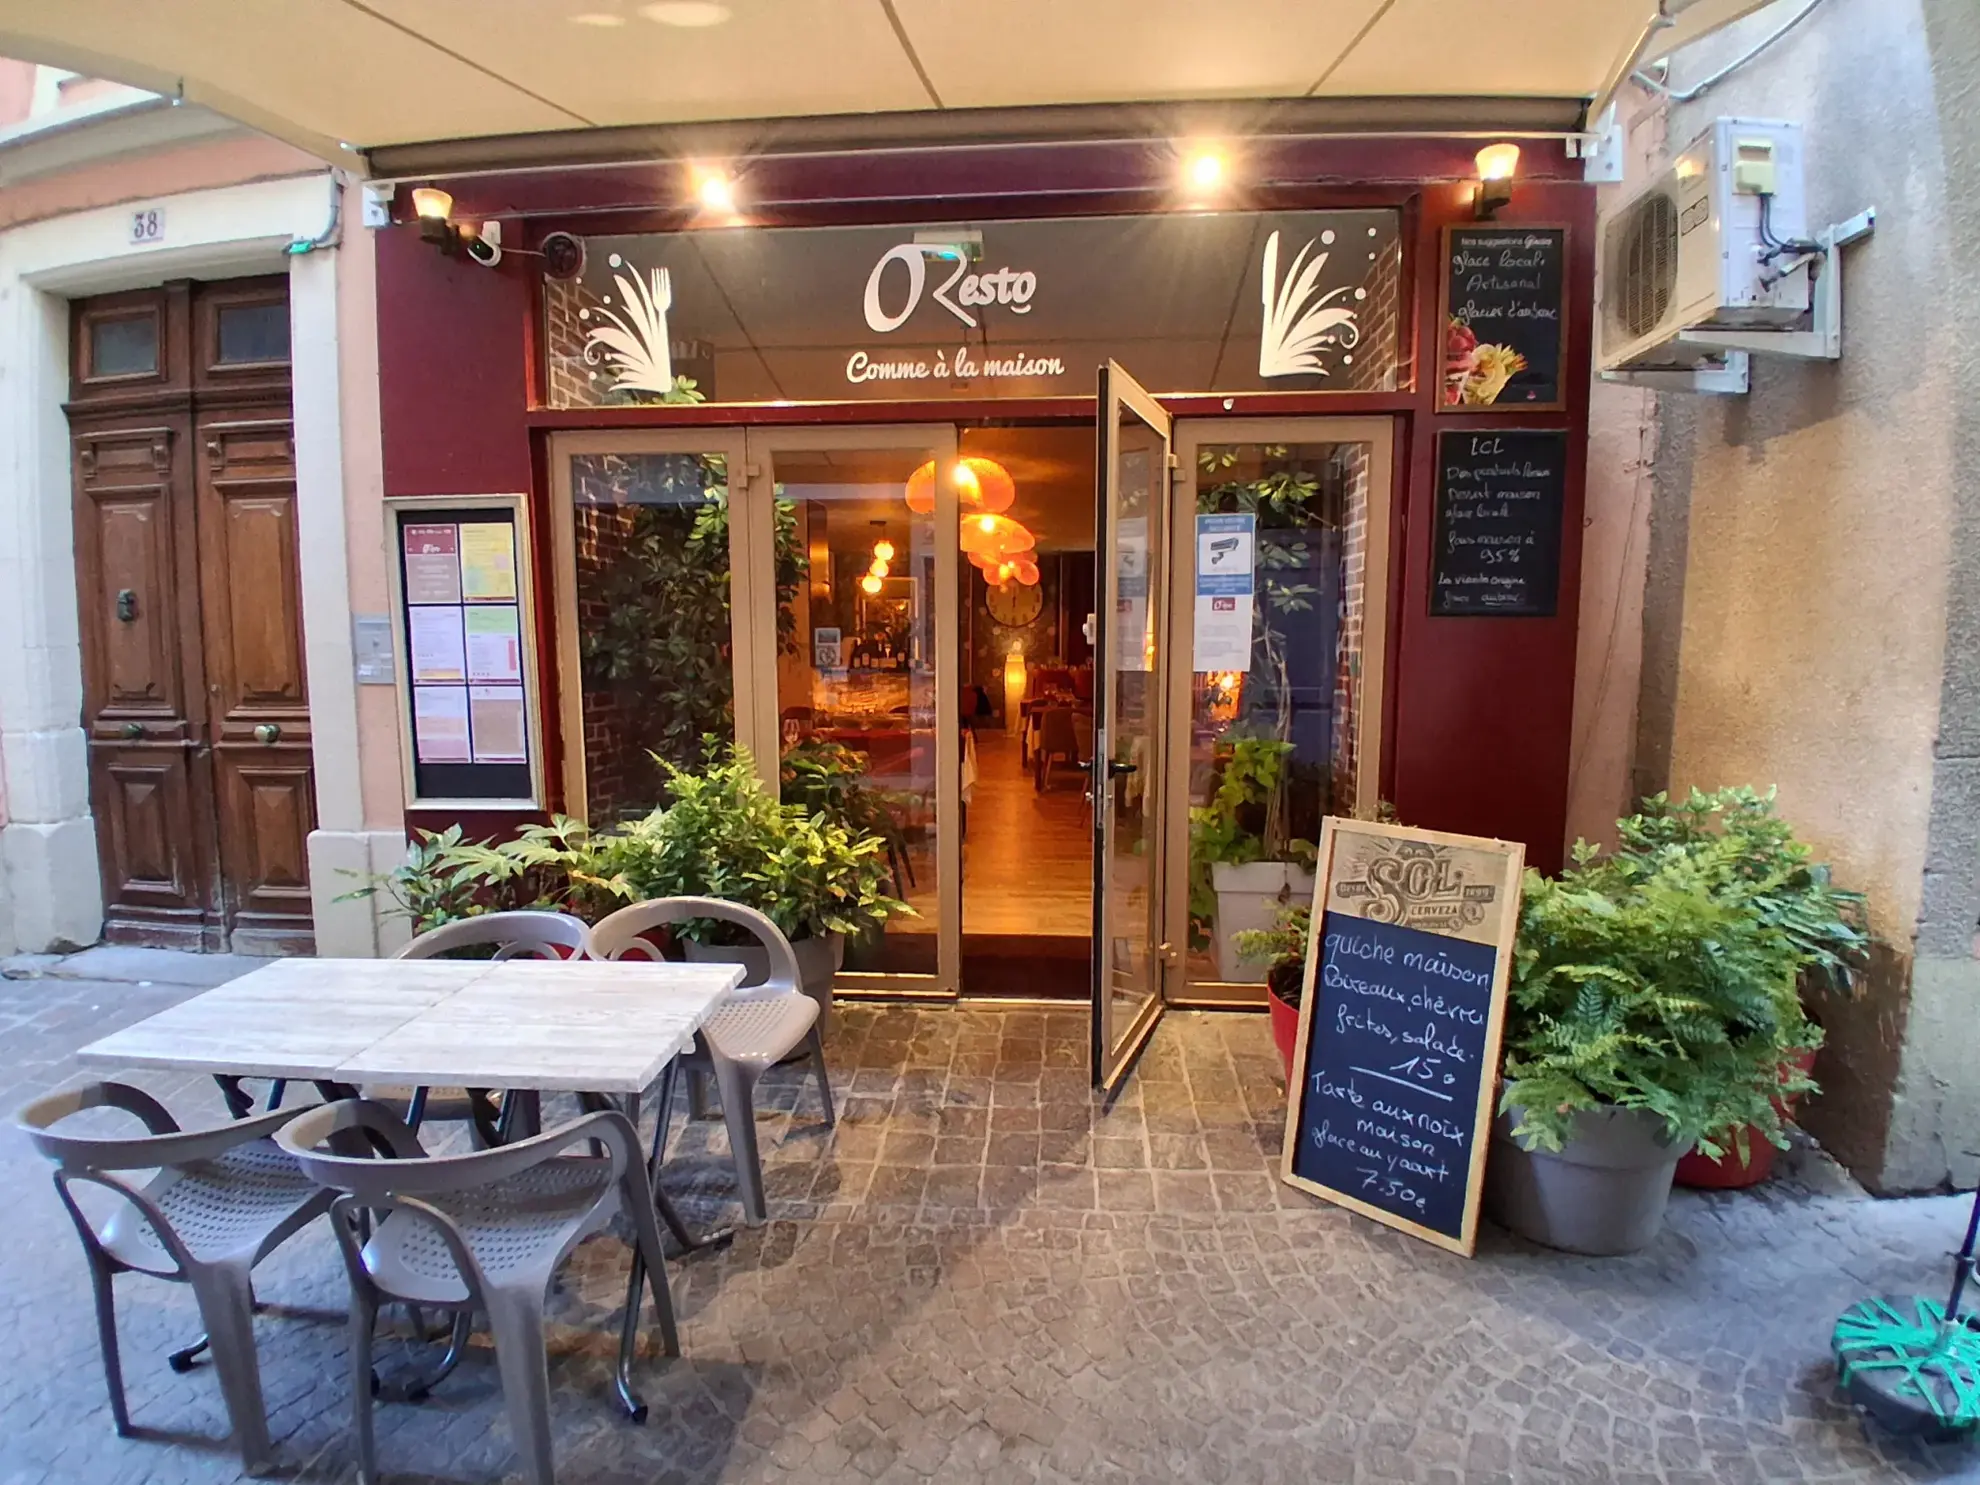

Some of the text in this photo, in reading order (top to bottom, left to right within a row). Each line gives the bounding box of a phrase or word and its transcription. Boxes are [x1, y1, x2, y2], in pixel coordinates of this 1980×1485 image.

[134, 211, 158, 238] 38
[1452, 250, 1490, 275] glace
[846, 346, 1065, 383] Comme à la maison
[1360, 857, 1465, 926] SOL
[1411, 904, 1458, 916] CERVEZA
[1325, 933, 1489, 992] quiche maison
[1312, 1071, 1464, 1147] Tarte aux noix
[1312, 1120, 1355, 1152] glace
[1360, 1146, 1382, 1160] au
[1356, 1120, 1435, 1157] maison
